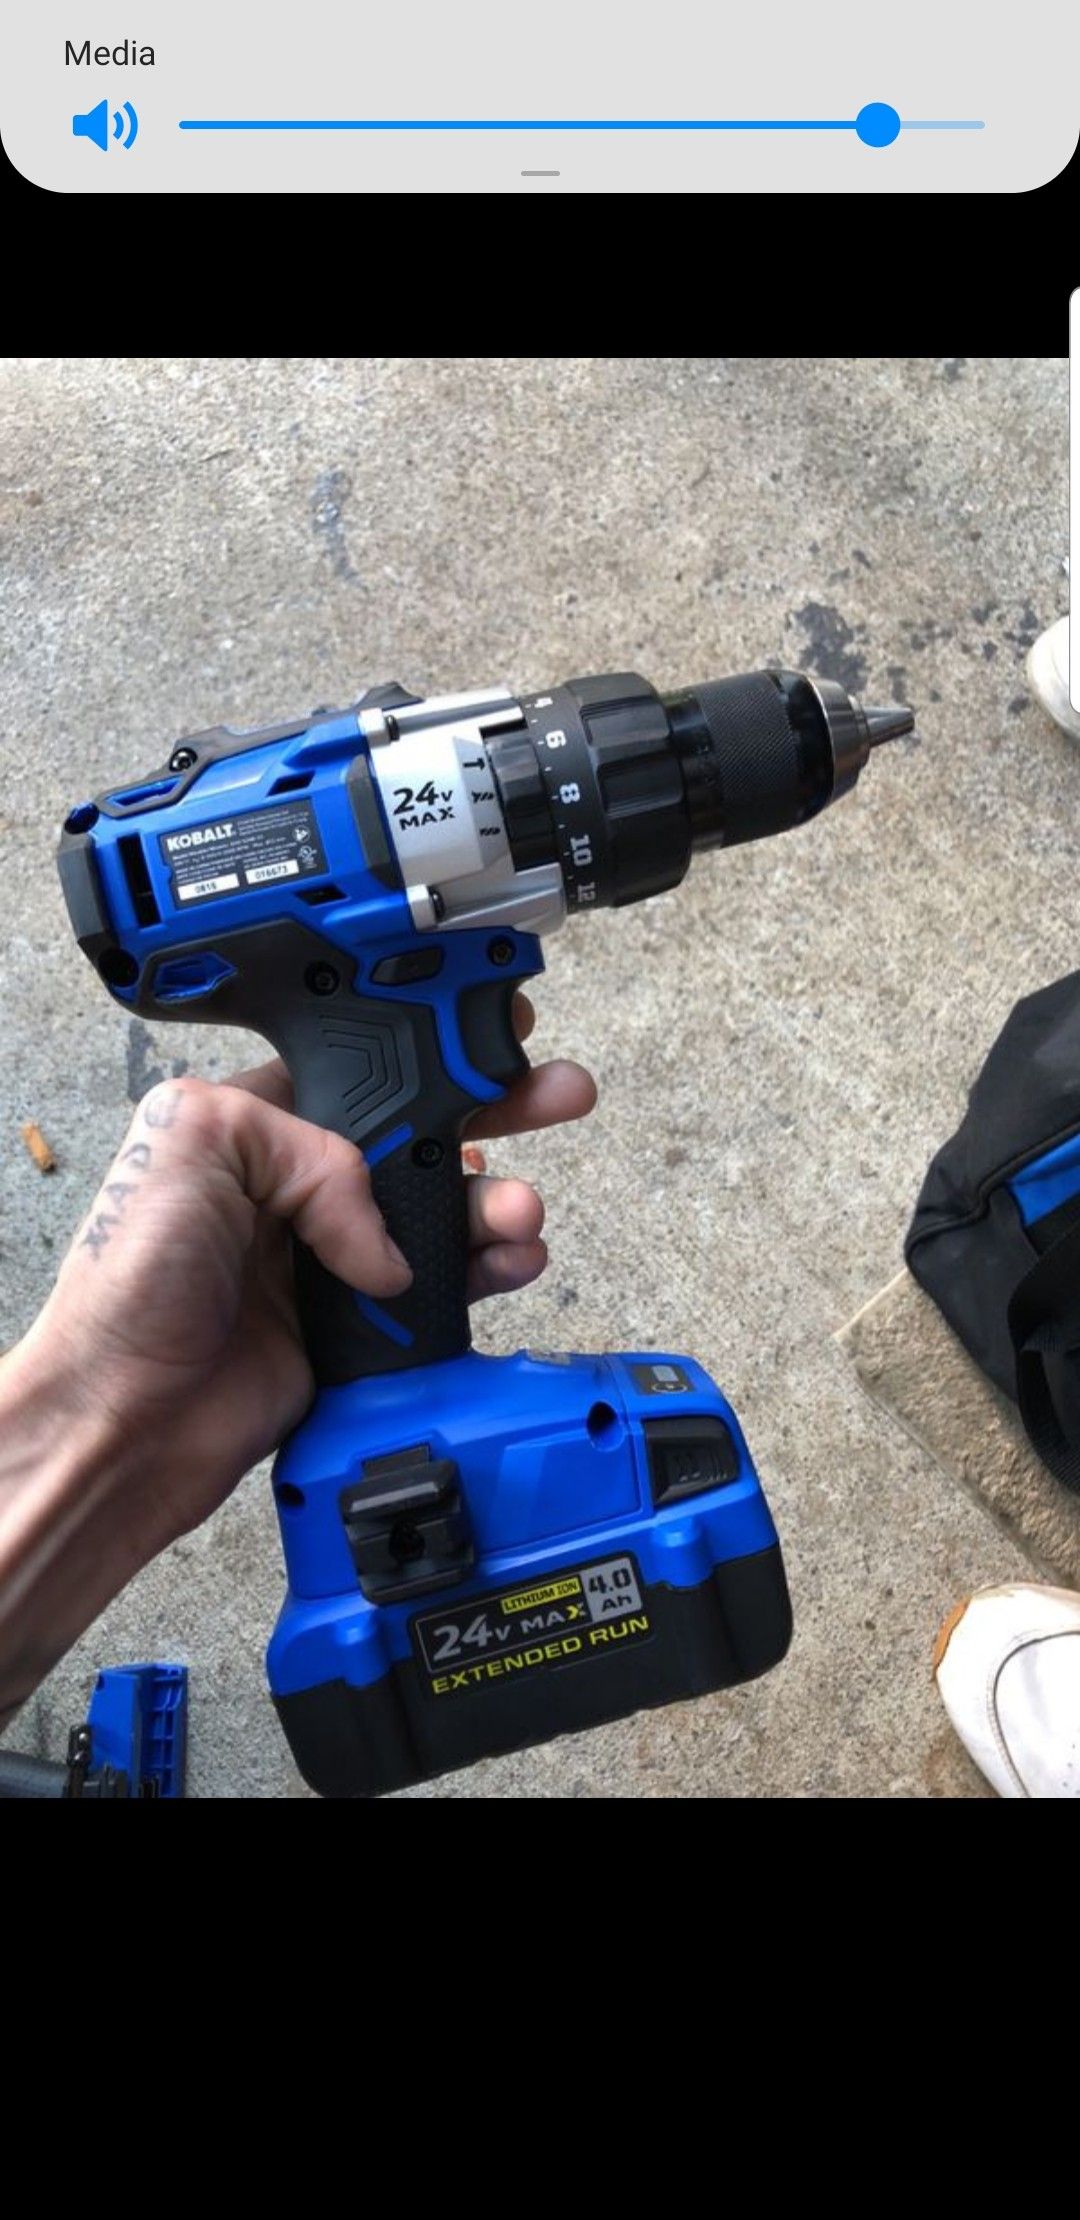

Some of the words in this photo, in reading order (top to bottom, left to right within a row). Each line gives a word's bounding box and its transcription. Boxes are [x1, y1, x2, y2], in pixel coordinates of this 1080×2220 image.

[64, 38, 156, 67] Media
[545, 730, 566, 748] 6
[559, 782, 581, 804] 8
[399, 806, 456, 831] MAX
[166, 823, 234, 851] KOBALT
[570, 834, 592, 867] 10
[577, 881, 596, 902] 12
[588, 1567, 632, 1593] 4.0
[503, 1588, 555, 1611] LITHIUM
[557, 1582, 579, 1597] ION
[601, 1595, 632, 1612] Ah
[521, 1603, 586, 1633] MAX
[431, 1636, 582, 1694] EXTENDED
[589, 1616, 650, 1645] RUN
